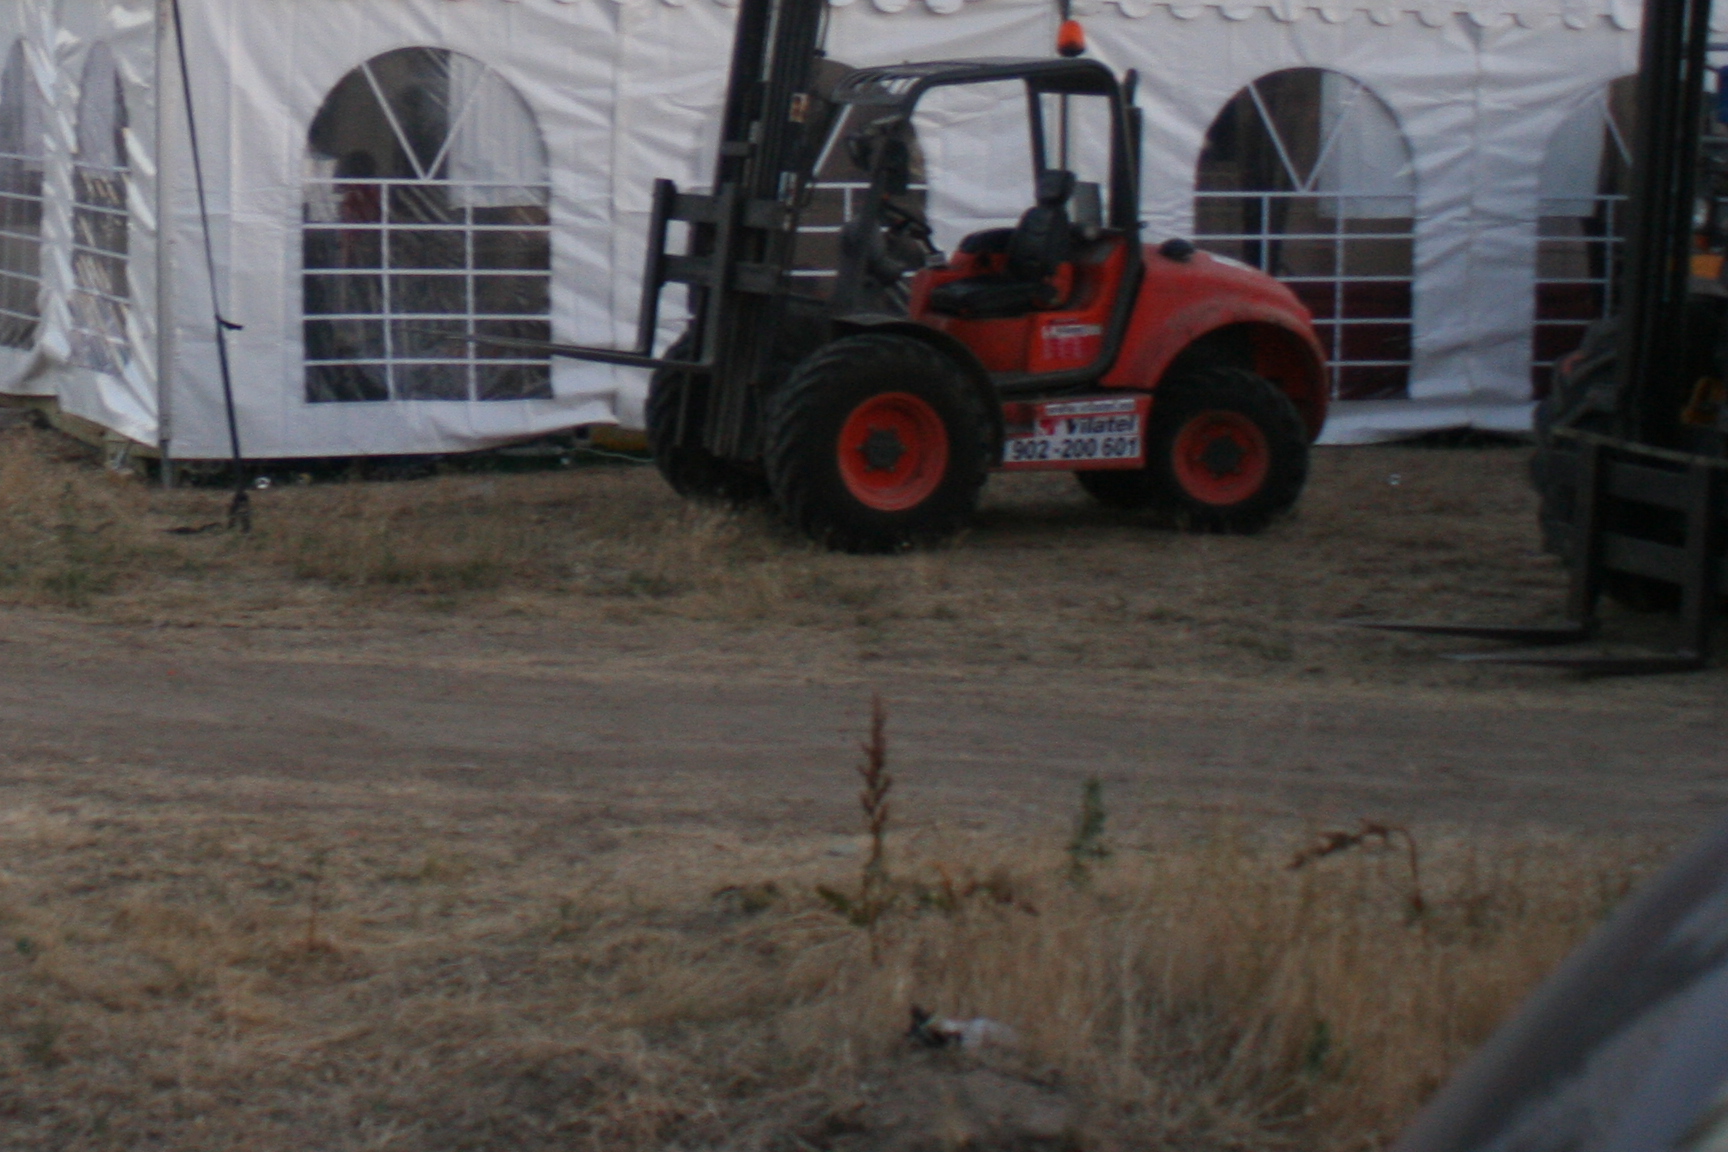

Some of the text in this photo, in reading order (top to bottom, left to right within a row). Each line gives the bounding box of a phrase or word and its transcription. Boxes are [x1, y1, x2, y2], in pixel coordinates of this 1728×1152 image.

[1066, 415, 1137, 435] Vilatel
[1011, 439, 1049, 460] 902
[1102, 437, 1138, 457] 601
